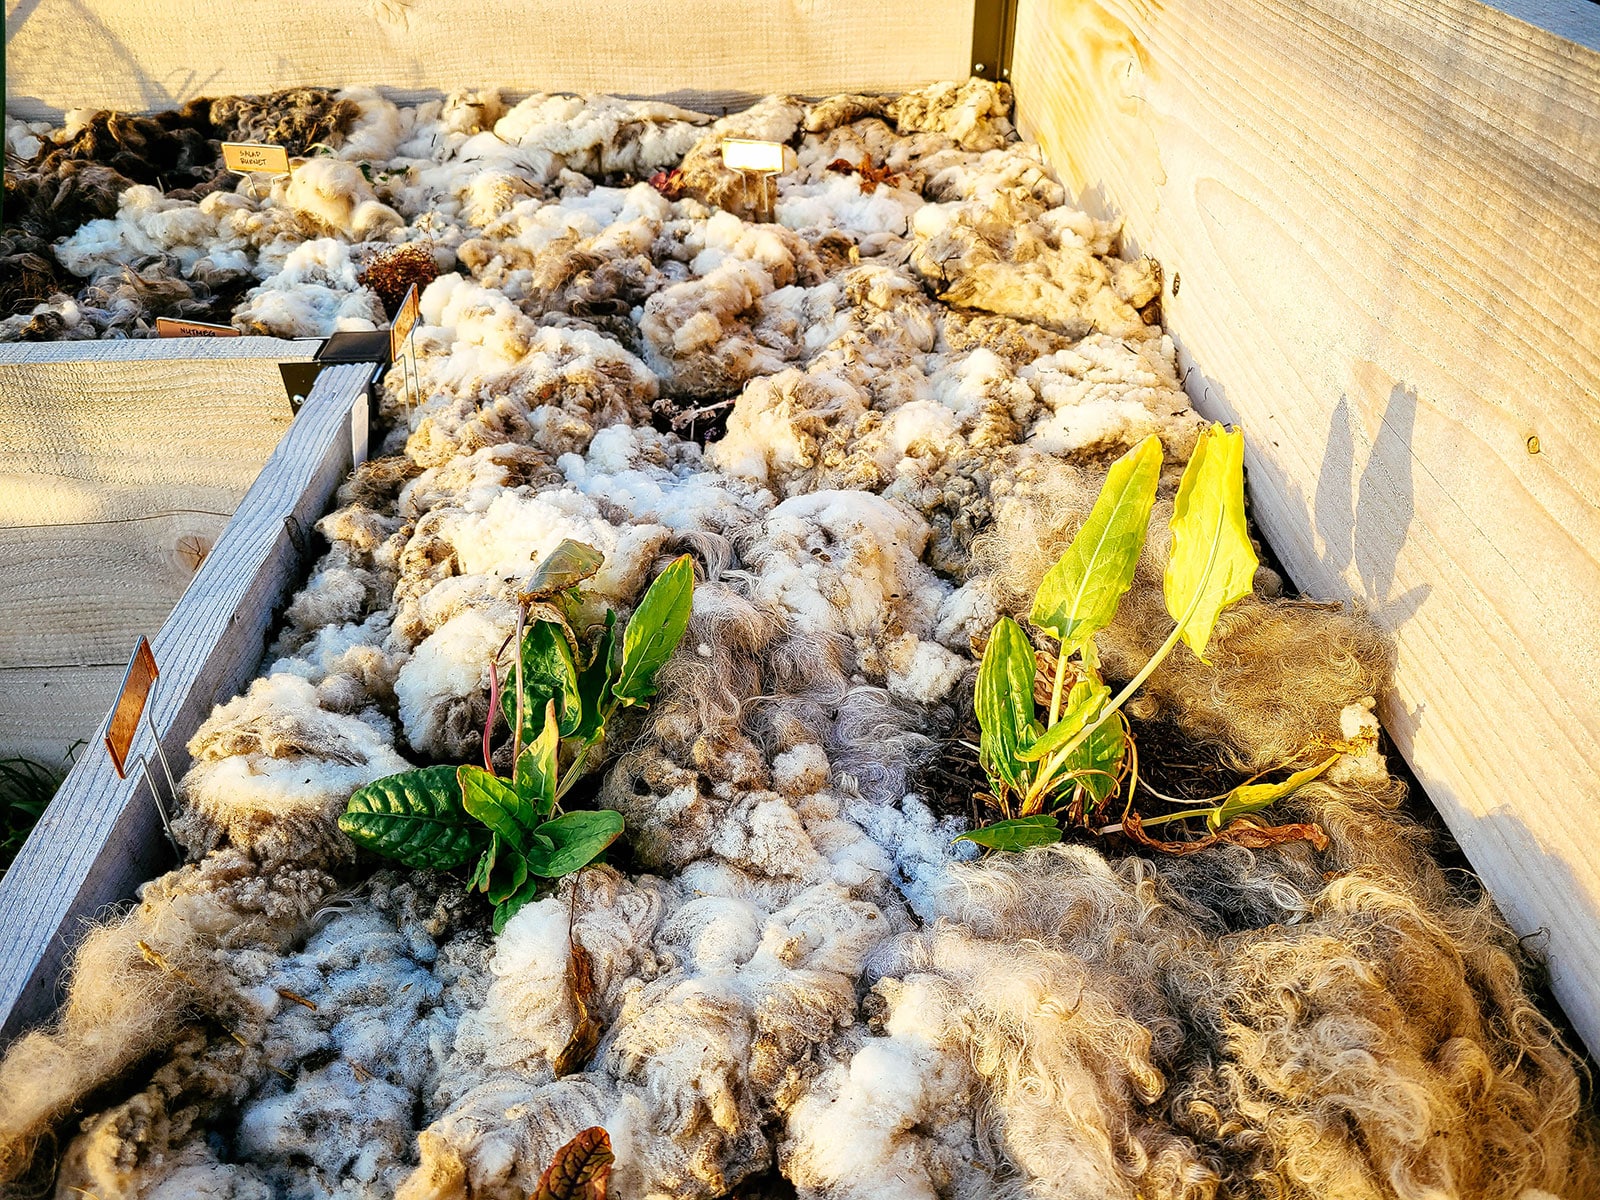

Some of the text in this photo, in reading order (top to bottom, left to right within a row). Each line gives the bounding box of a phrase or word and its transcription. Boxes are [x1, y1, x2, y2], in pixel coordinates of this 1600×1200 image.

[239, 150, 261, 158] SALAD
[240, 158, 267, 166] BURNET
[180, 327, 216, 337] NUTMEG
